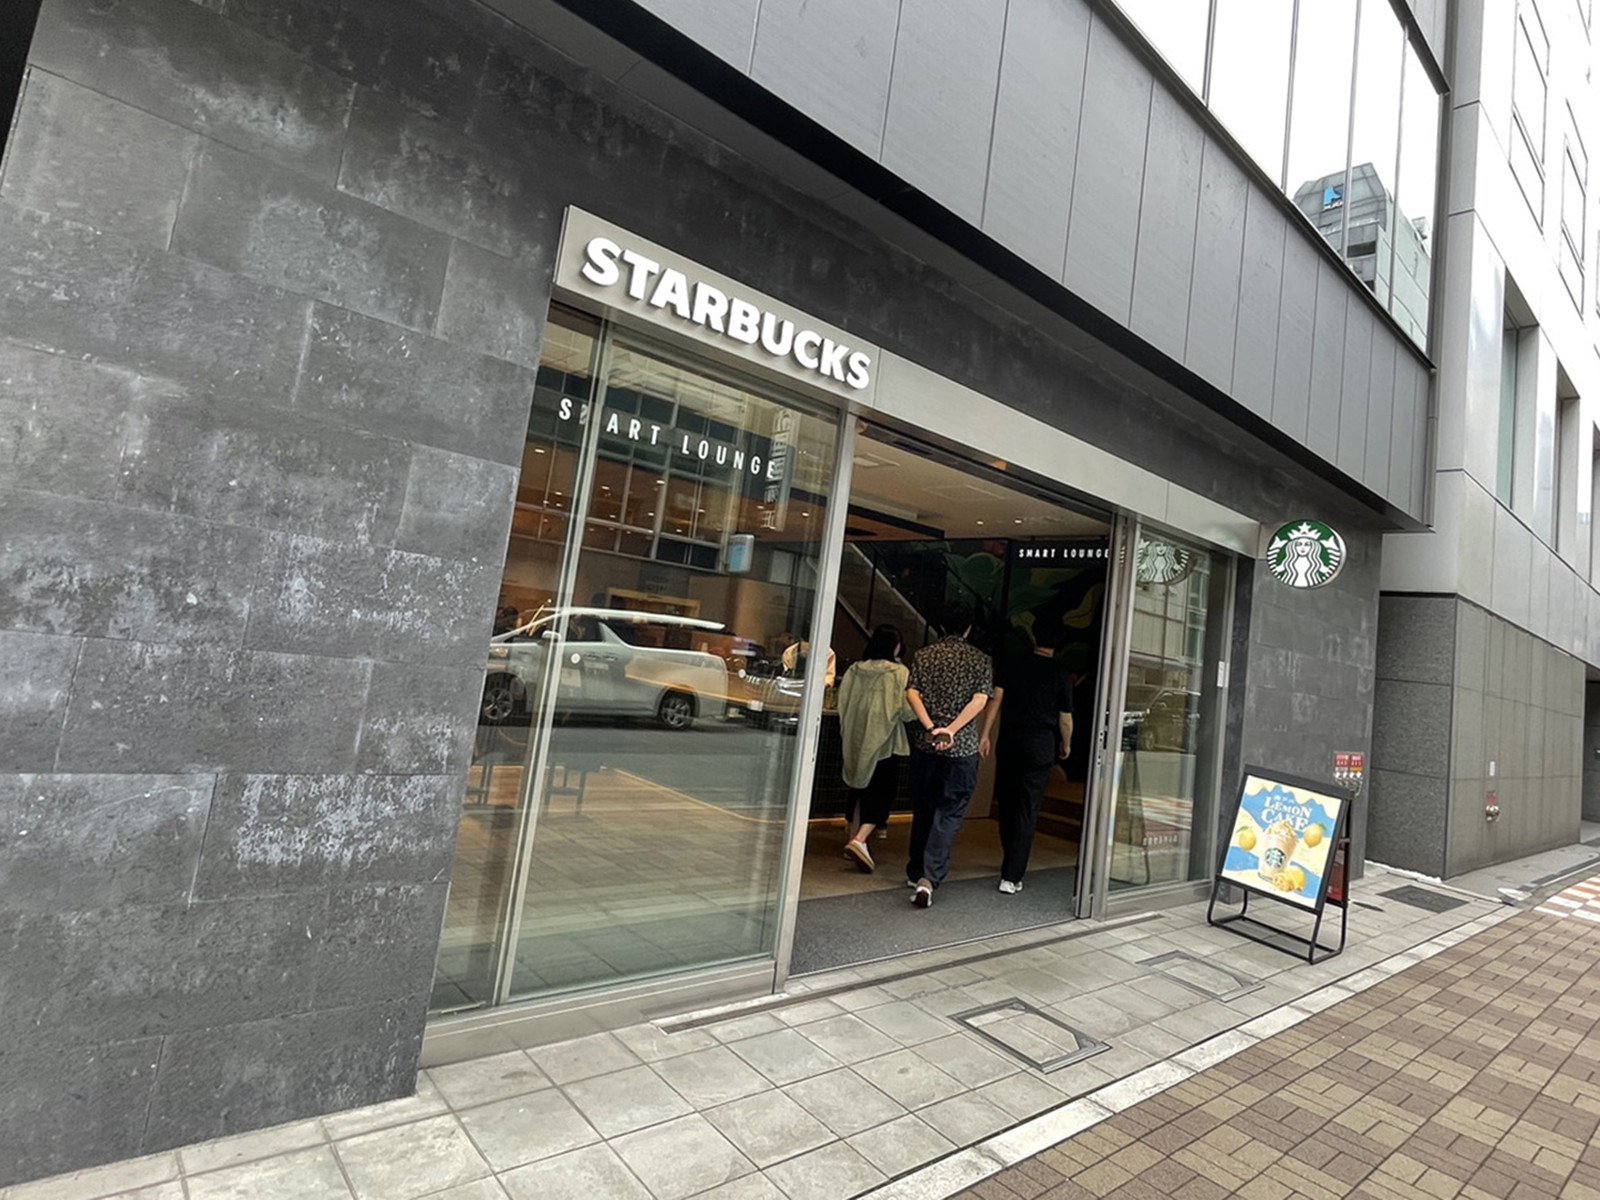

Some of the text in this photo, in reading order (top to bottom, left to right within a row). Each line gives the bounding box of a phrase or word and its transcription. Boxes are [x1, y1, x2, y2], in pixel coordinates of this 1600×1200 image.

[581, 237, 871, 390] STARBUCKS
[682, 434, 776, 479] LOUNGE
[1018, 548, 1109, 558] SMART LOUNGE
[1262, 808, 1309, 830] CAKE
[1264, 796, 1313, 819] LEMON
